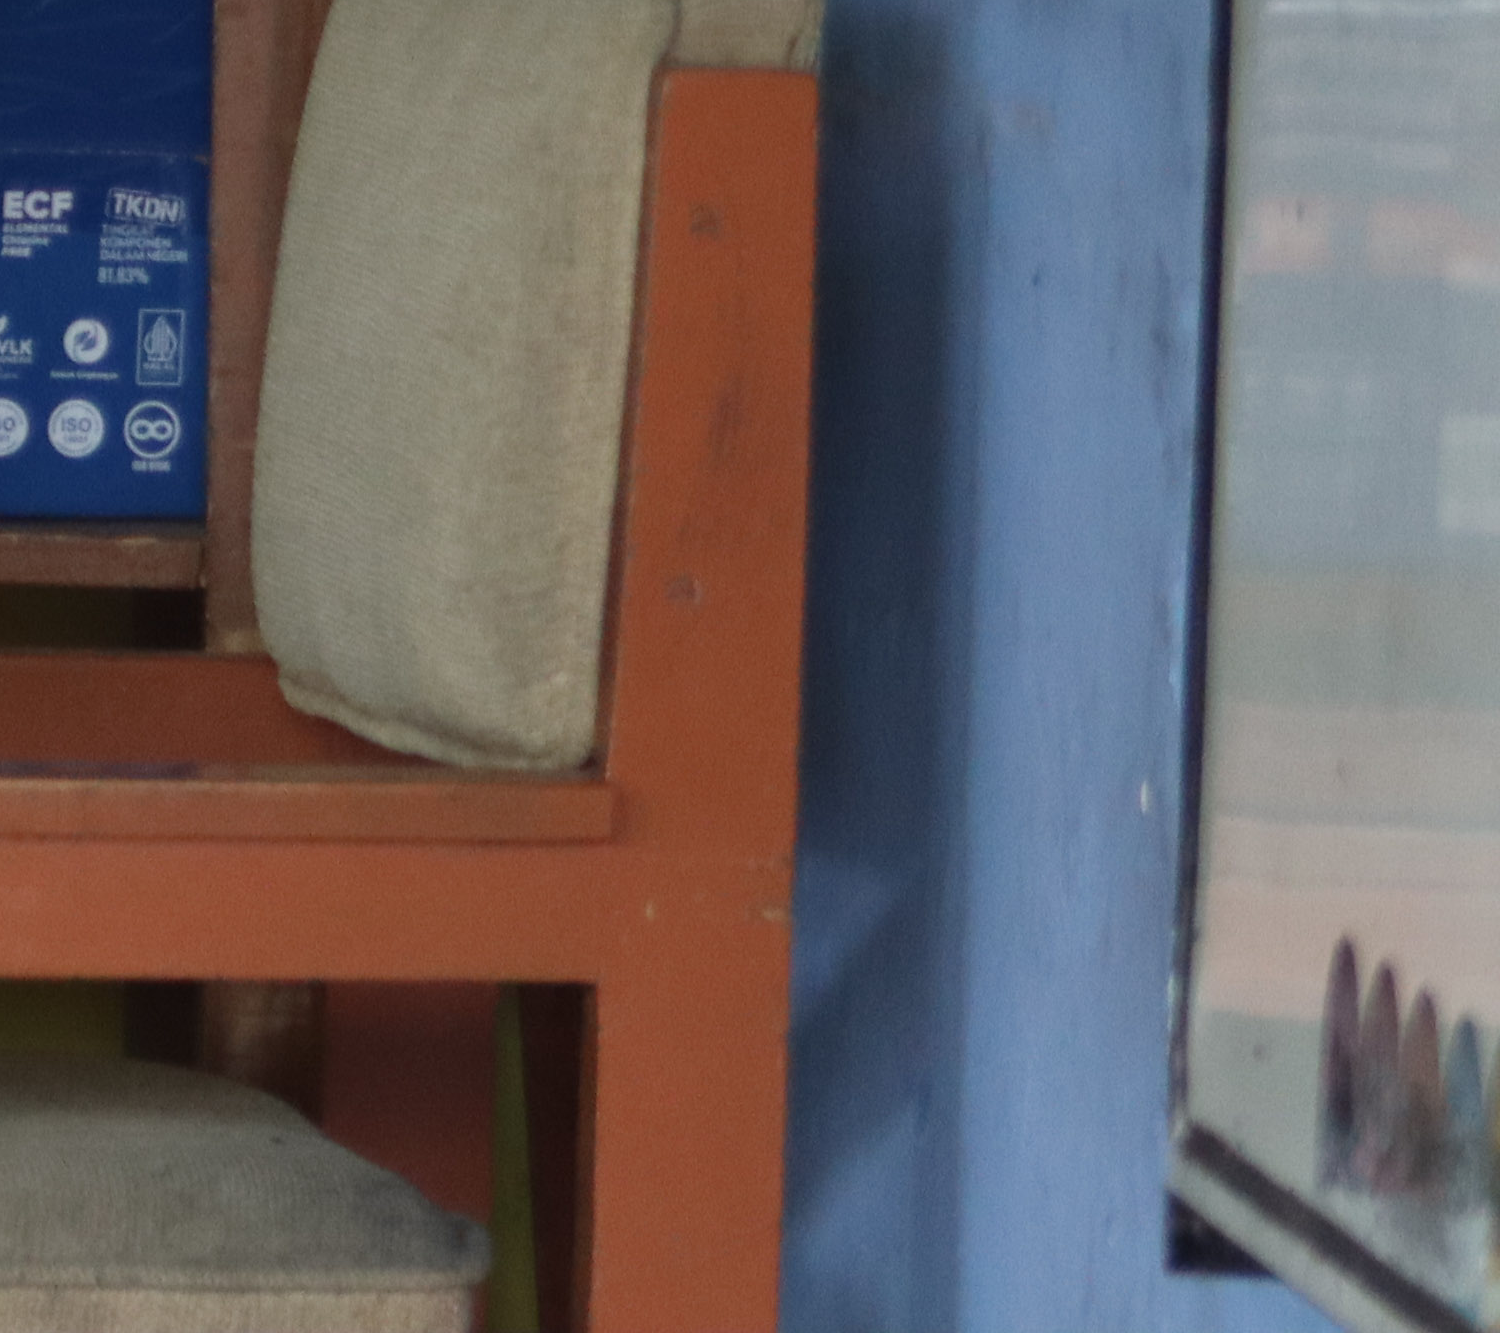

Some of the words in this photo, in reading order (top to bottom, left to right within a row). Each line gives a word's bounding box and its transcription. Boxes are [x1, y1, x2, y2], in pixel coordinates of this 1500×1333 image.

[2, 190, 74, 220] ECF
[112, 191, 182, 224] TKDN
[60, 418, 92, 433] ISO
